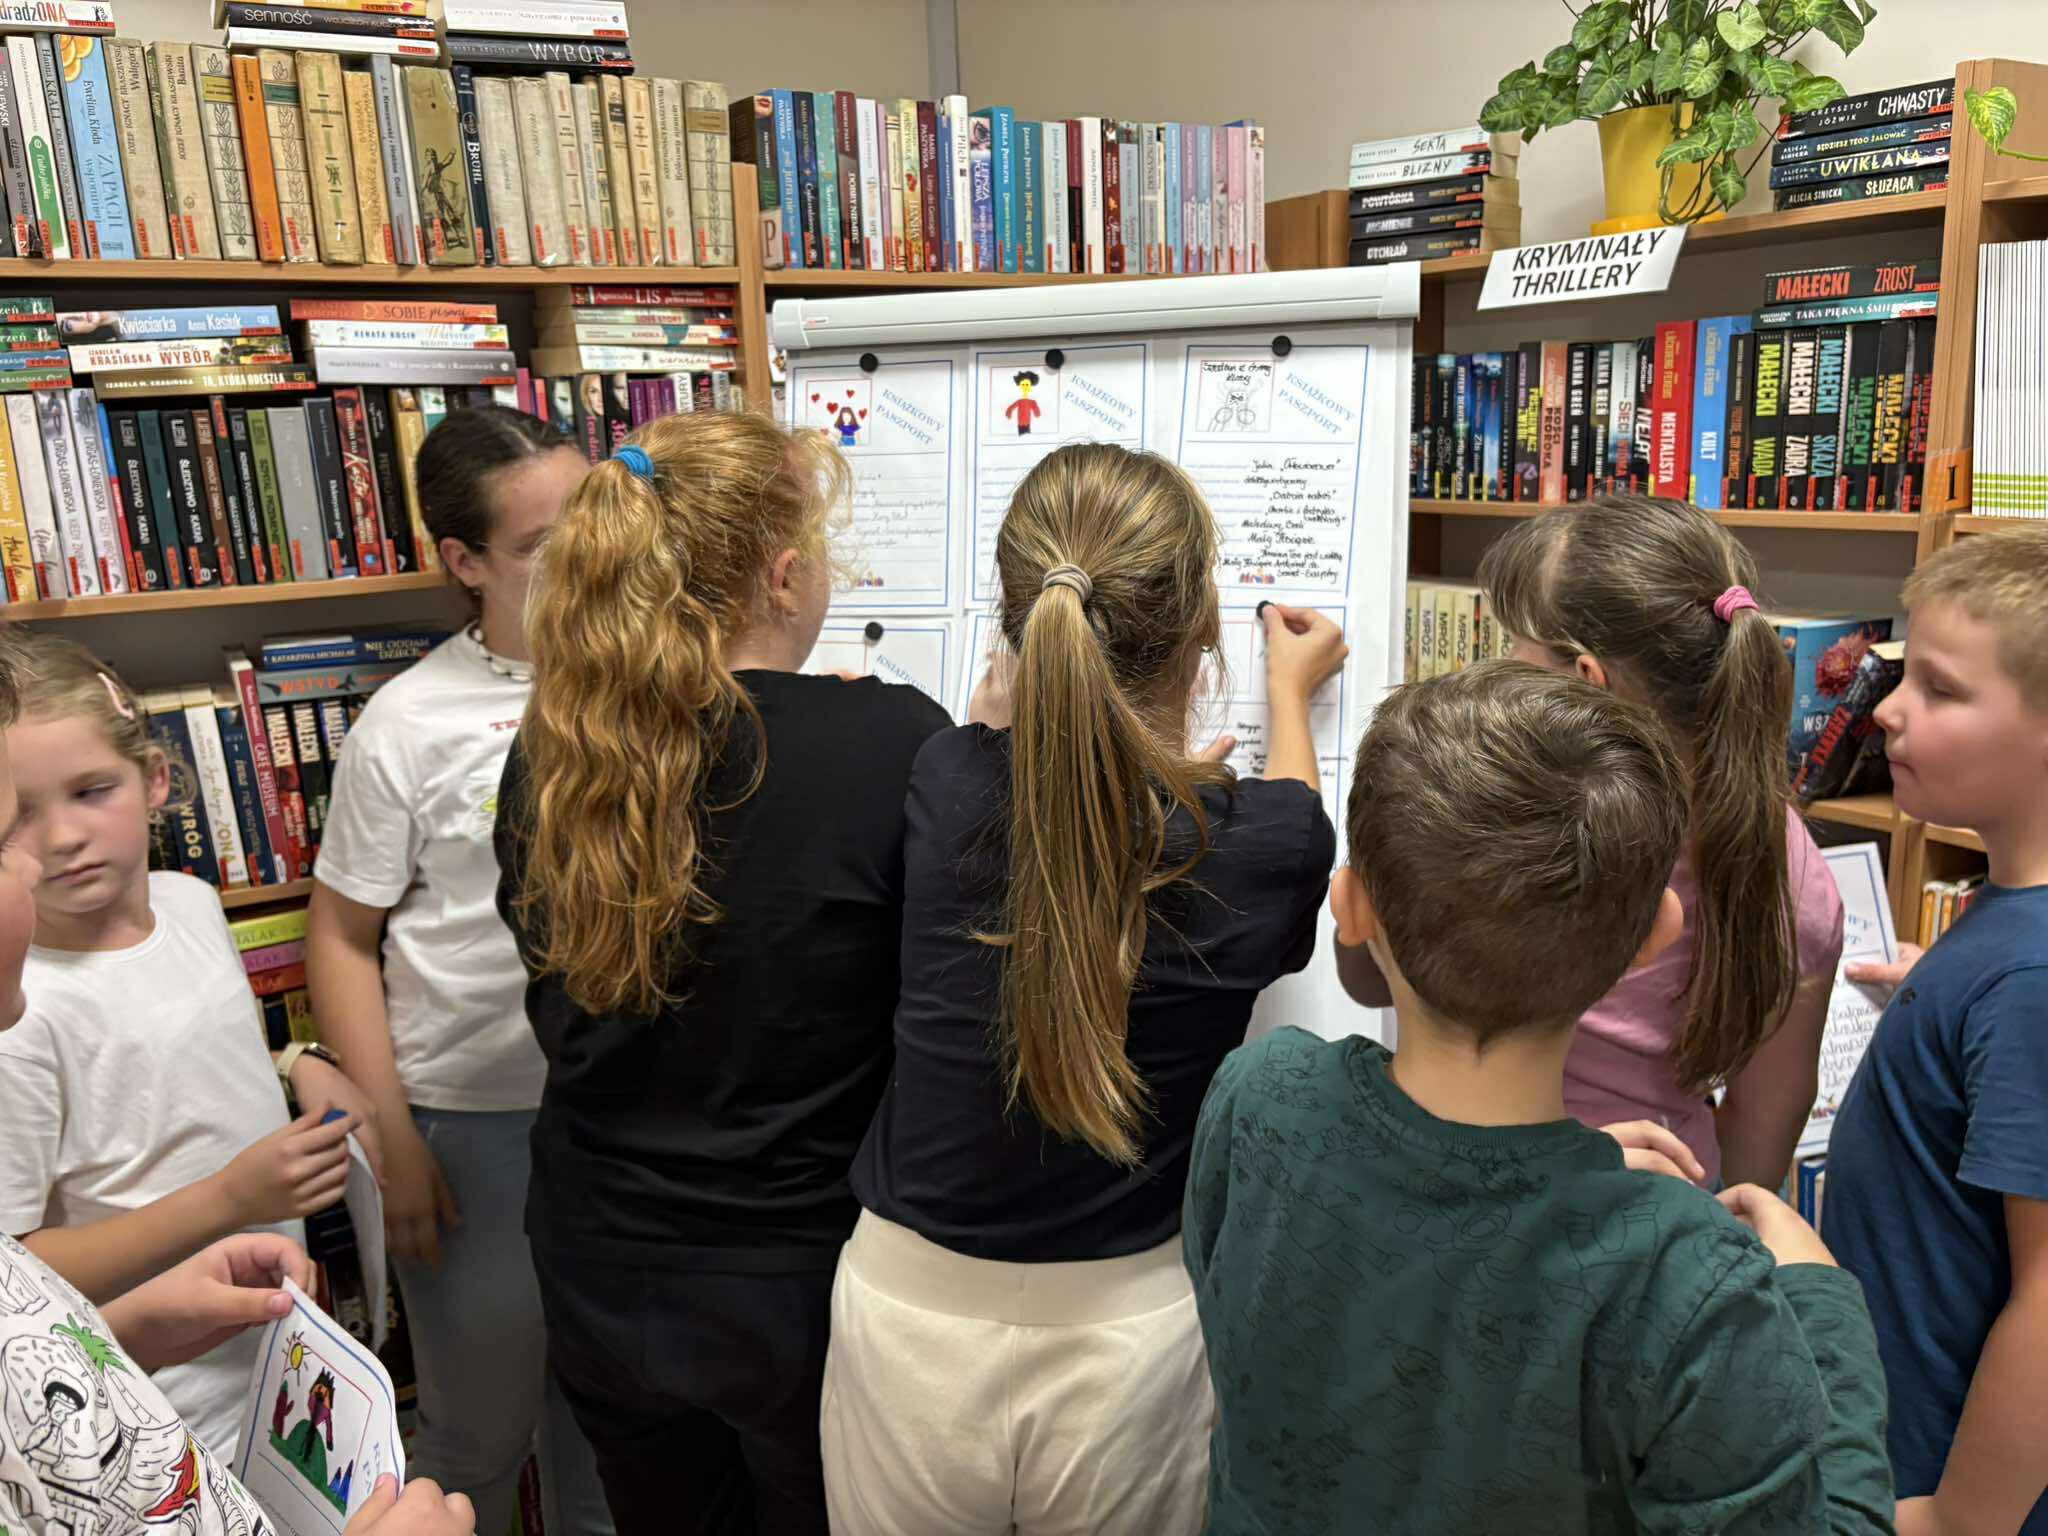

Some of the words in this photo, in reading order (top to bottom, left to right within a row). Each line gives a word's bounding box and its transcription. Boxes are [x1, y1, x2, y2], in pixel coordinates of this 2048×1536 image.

[244, 9, 313, 25] senność
[528, 41, 606, 62] WYBÓR
[81, 79, 99, 117] Ewelina
[1878, 88, 1945, 116] CHWASTY
[1000, 113, 1009, 146] IZABELA
[1413, 135, 1446, 153] SEKTA
[1402, 159, 1452, 176] BLIZNY
[848, 173, 857, 205] DOBRY
[1512, 230, 1666, 271] KRYMINAŁY
[635, 290, 661, 304] LIS
[1512, 262, 1641, 298] THRILLERY
[1776, 272, 1850, 300] MAŁECKI
[1874, 265, 1917, 293] ZROST
[120, 316, 176, 335] Kwiaciarka
[383, 305, 426, 319] SOBIE
[1796, 309, 1822, 320] TAKA
[1825, 306, 1863, 321] PIĘKNA
[90, 353, 152, 367] KRASIŃSKA
[160, 349, 213, 365] WYBÓR
[1572, 351, 1584, 385] HANNA
[1815, 338, 1842, 414] MAŁECKI
[1072, 374, 1136, 418] KSIĄŻKOWY
[1285, 372, 1356, 421] KSIĄŻKOWY
[1755, 343, 1781, 417] MAŁECKI
[1787, 341, 1814, 416] MAŁECKI
[876, 404, 934, 445] PASZPORT
[882, 389, 944, 431] KSIĄŻKOWY
[1064, 391, 1126, 432] PASZPORT
[1278, 389, 1341, 435] PASZPORT
[1553, 407, 1561, 444] KOŚCI
[1844, 377, 1875, 464] MAŁECKI
[1872, 374, 1904, 464] MAŁECKI
[119, 418, 136, 448] LEM
[170, 418, 188, 449] LEM
[195, 416, 212, 446] LEM
[1543, 408, 1552, 469] PROROKA
[1657, 412, 1676, 484] MENTALISTA
[1700, 431, 1717, 461] KULT
[53, 437, 78, 514] LINGAS-ŁONIEWSKA
[83, 435, 107, 512] LINGAS-ŁONIEWSKA
[1751, 436, 1775, 477] WADA
[1784, 435, 1808, 478] ZADRA
[1810, 434, 1836, 479] SKAZA
[126, 458, 145, 508] ŚLEDZTWO
[136, 515, 150, 545] KATAR
[178, 458, 198, 508] ŚLEDZTWO
[189, 514, 203, 544] KATAR
[1422, 609, 1431, 657] MRÓZ
[1438, 612, 1448, 660] MRÓZ
[1457, 614, 1466, 662] MRÓZ
[265, 711, 294, 769] MAŁECKI
[292, 706, 322, 764] MAŁECKI
[259, 770, 278, 817] MUSEUM
[178, 801, 203, 860] WRÓG
